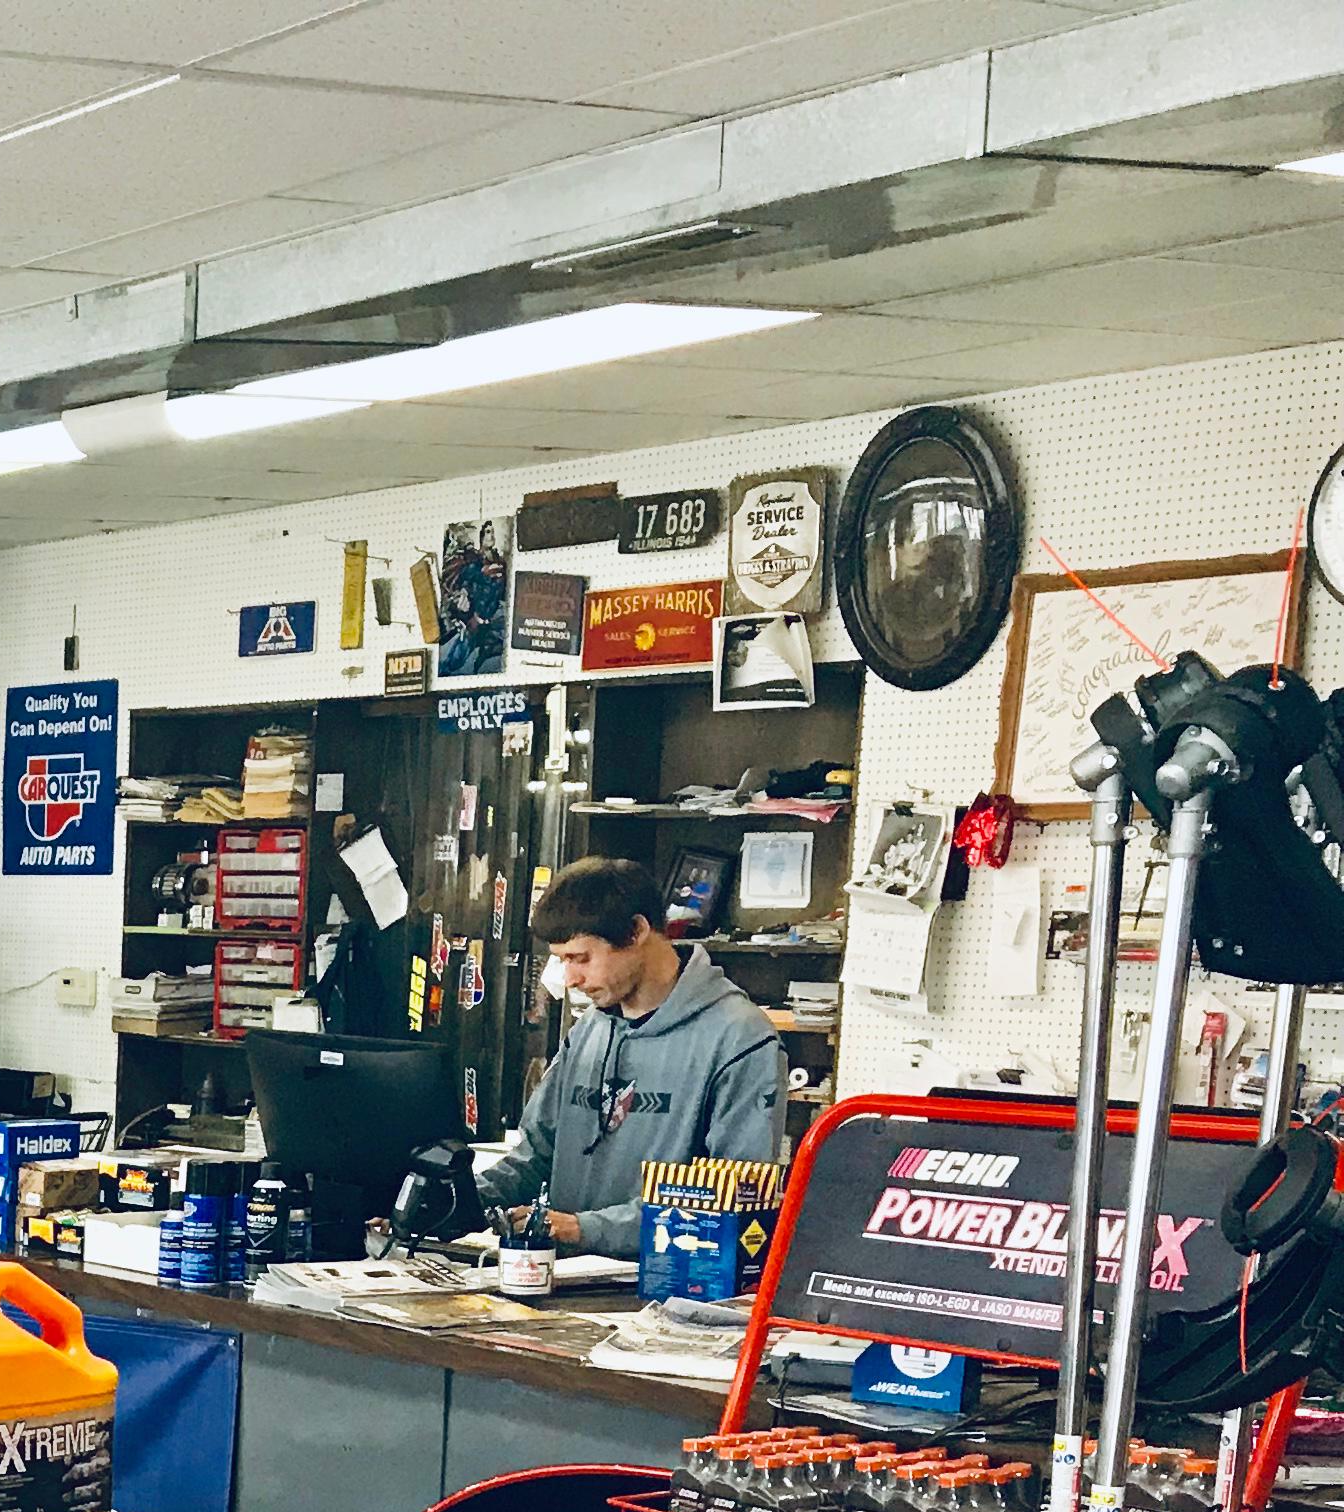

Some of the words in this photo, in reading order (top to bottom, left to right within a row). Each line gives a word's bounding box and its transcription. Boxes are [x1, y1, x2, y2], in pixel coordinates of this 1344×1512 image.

[636, 505, 657, 538] 17
[665, 499, 705, 536] 683
[747, 506, 804, 526] SERVICE
[752, 524, 798, 541] Dealer
[589, 588, 714, 629] MASSEY-HARRIS
[25, 694, 70, 713] Quality
[73, 693, 98, 709] You
[438, 693, 526, 719] EMPLOYEES
[10, 720, 34, 737] Can
[38, 717, 83, 738] Depend
[85, 715, 112, 732] On!
[457, 714, 504, 731] ONLY
[20, 772, 100, 802] CARQUEST
[20, 846, 51, 866] AUTO
[54, 845, 95, 866] PARTS
[16, 1134, 72, 1155] Haldex
[912, 1149, 1020, 1189] ECHO
[1149, 1269, 1185, 1293] OIL
[823, 1279, 853, 1297] Meets
[855, 1283, 873, 1299] and
[875, 1286, 915, 1304] exceeds
[916, 1290, 970, 1312] ISO-L-EGD
[971, 1299, 980, 1312] &
[982, 1301, 1012, 1317] JASO
[1013, 1304, 1062, 1325] M345/FD
